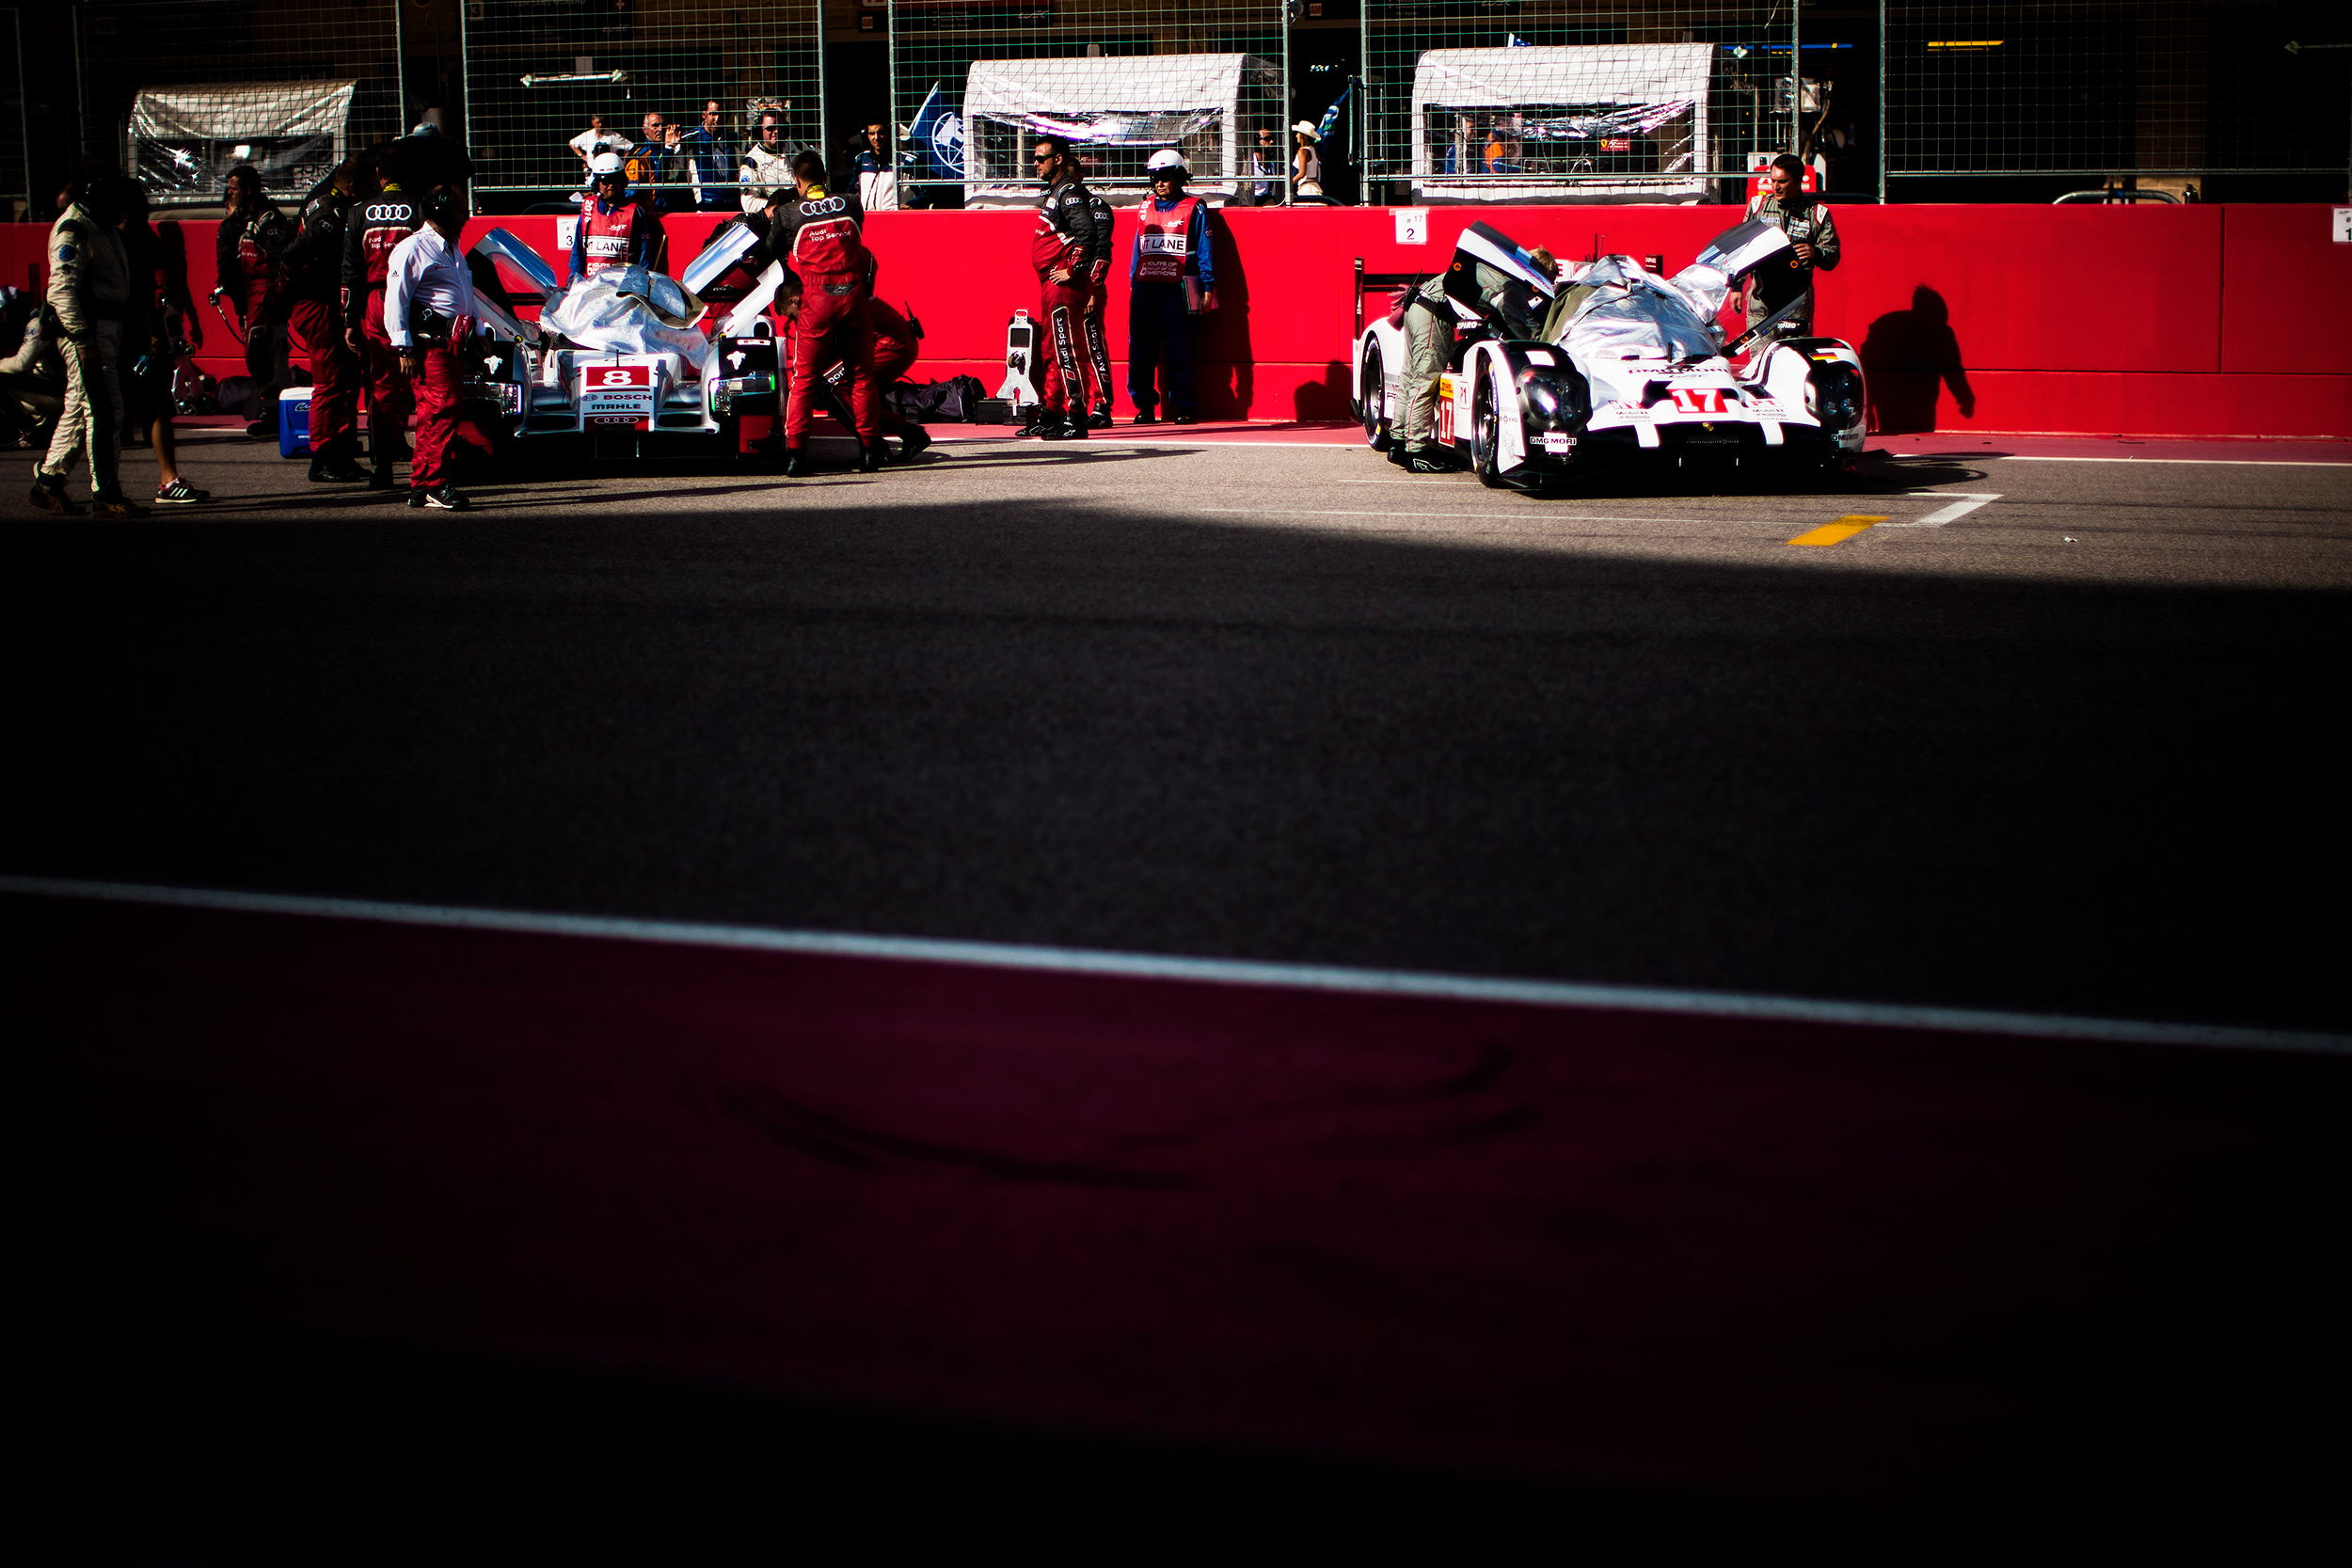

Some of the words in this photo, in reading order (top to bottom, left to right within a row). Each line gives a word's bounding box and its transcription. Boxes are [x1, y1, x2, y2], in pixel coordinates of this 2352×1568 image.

[565, 235, 574, 246] 3
[808, 230, 827, 239] Audi
[810, 237, 824, 245] Top
[826, 231, 851, 243] Service
[1406, 228, 1415, 240] 2
[596, 241, 628, 253] LANE
[1152, 239, 1184, 251] LANE
[1056, 317, 1068, 347] Sport
[1089, 323, 1100, 352] Sport
[1060, 347, 1073, 370] Audi
[1093, 350, 1107, 372] Audi
[602, 371, 632, 386] 8
[1671, 388, 1718, 413] 17
[1440, 401, 1453, 440] 17
